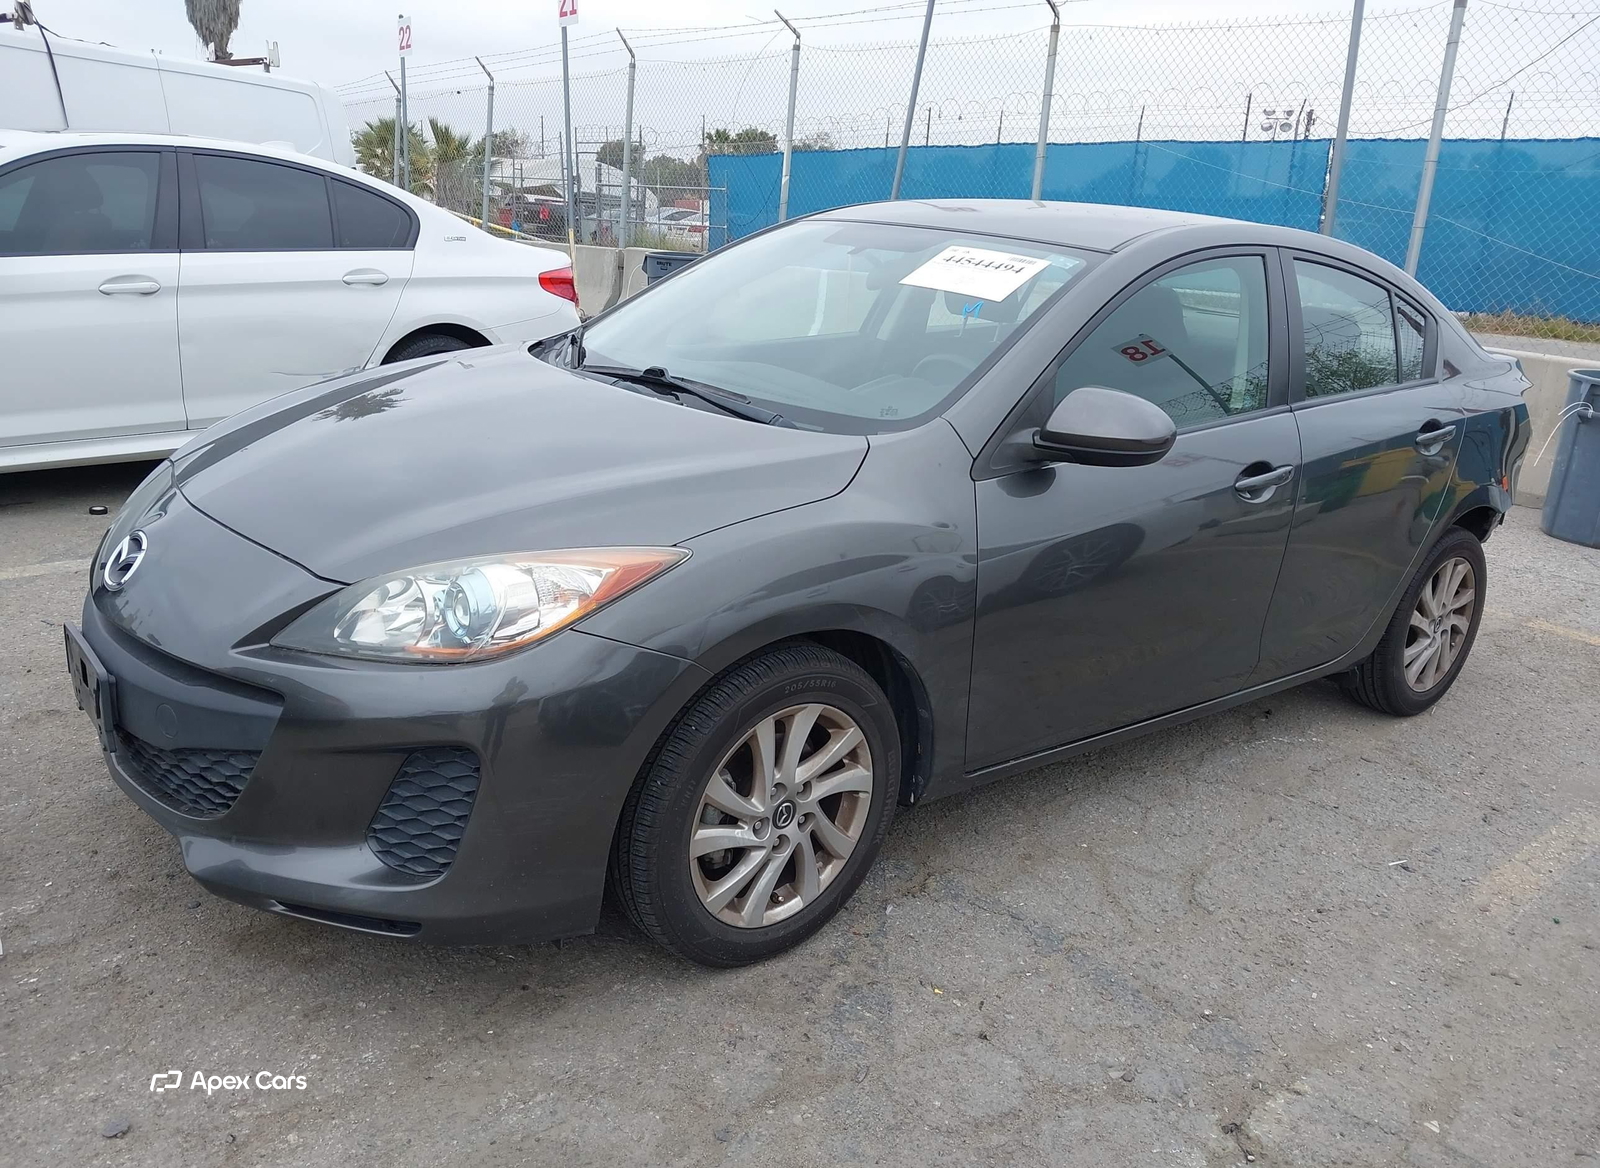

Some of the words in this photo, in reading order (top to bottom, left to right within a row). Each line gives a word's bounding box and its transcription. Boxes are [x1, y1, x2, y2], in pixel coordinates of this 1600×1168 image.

[399, 25, 412, 50] 22
[943, 255, 1025, 274] 44544494
[784, 679, 837, 694] 205/55R16
